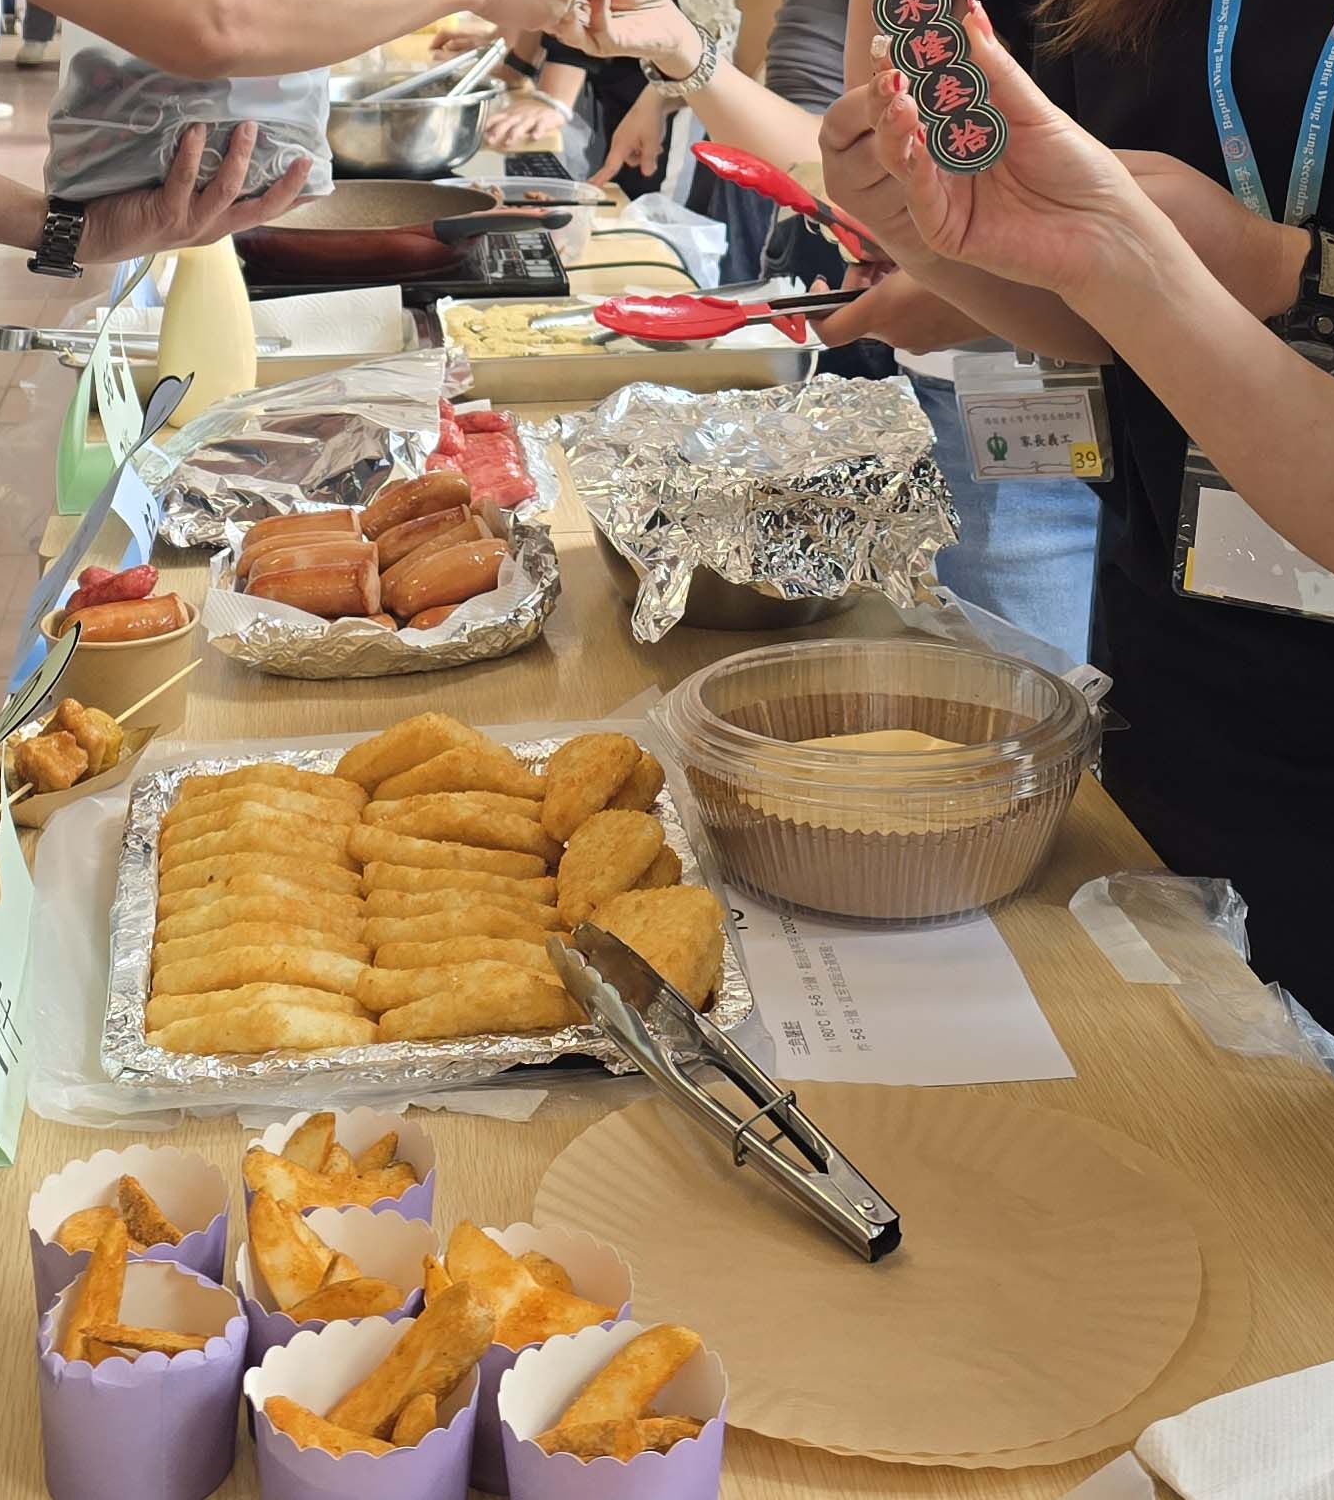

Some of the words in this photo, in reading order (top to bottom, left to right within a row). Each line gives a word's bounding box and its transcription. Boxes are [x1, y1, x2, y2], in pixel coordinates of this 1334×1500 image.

[1214, 25, 1228, 54] Lung
[1214, 54, 1224, 88] Wing
[1216, 89, 1234, 130] Baptist
[1310, 89, 1328, 121] Wing
[1302, 123, 1321, 156] Lung
[1292, 155, 1315, 218] Secondary
[1074, 451, 1097, 469] 39
